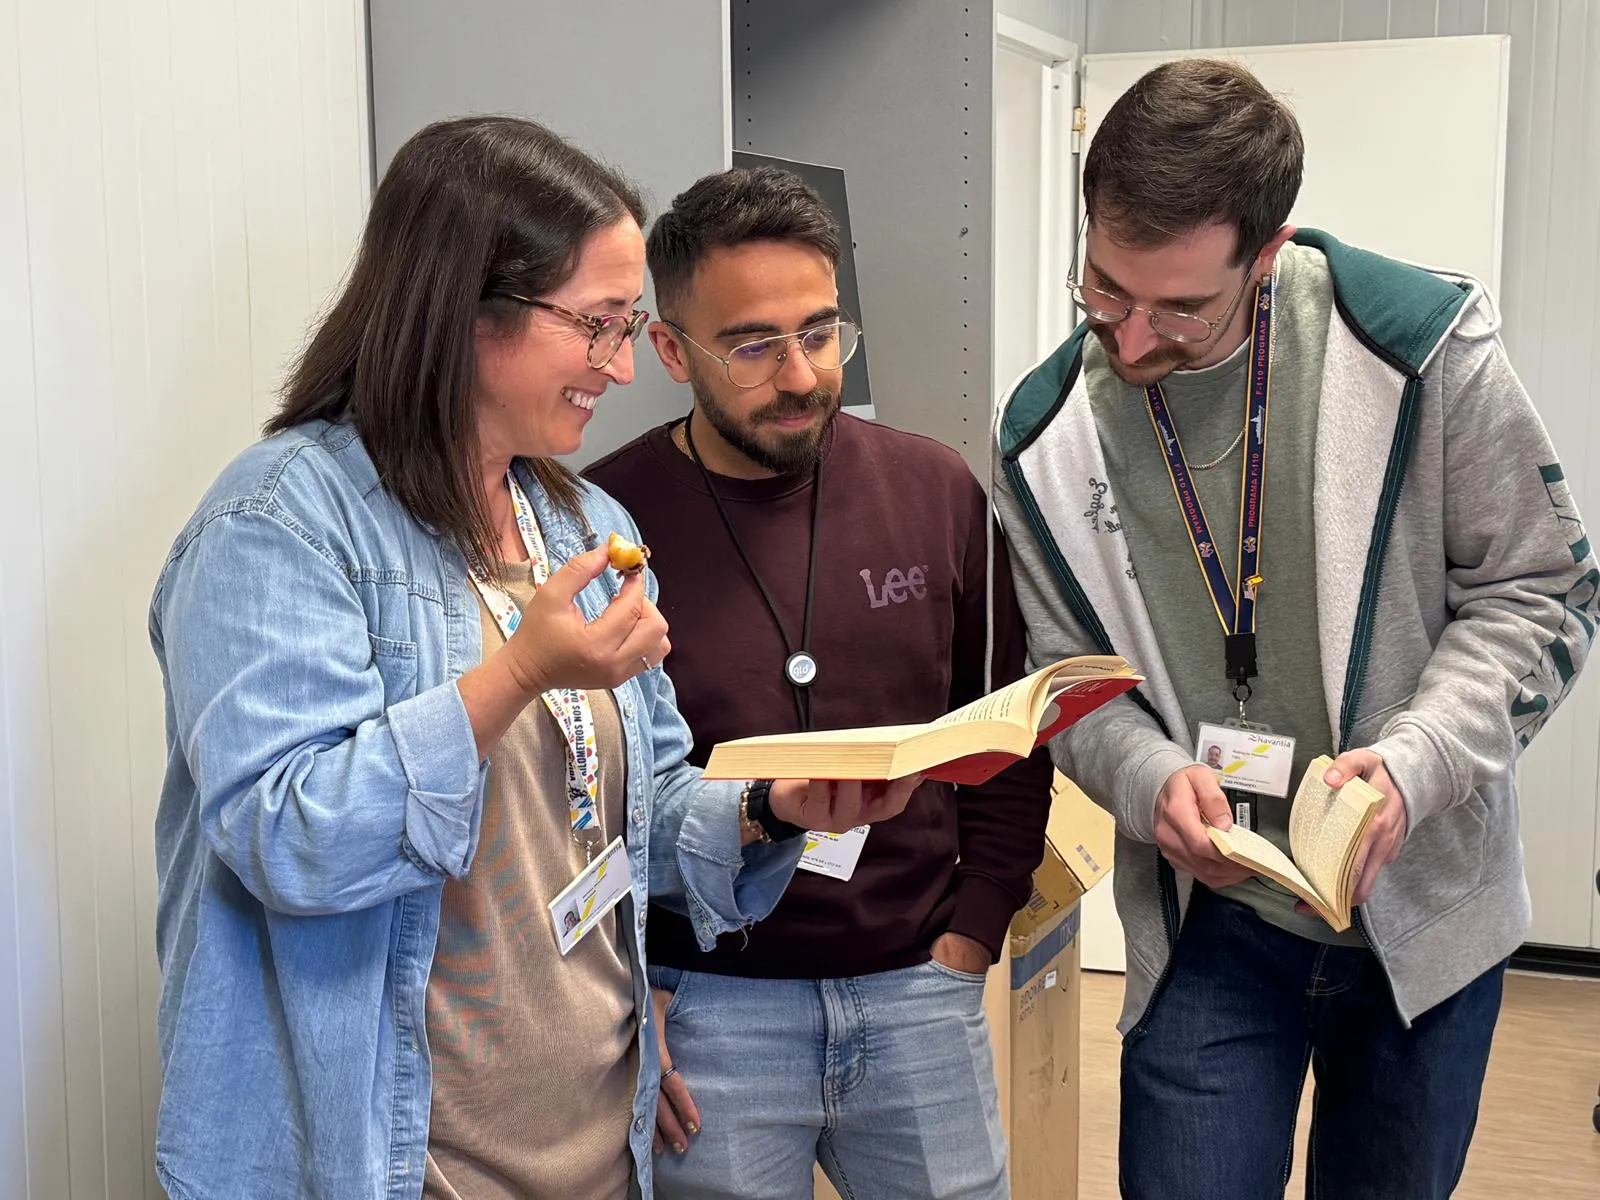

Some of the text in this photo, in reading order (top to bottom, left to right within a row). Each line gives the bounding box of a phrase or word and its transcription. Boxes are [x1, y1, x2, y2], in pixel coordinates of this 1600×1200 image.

[1257, 320, 1267, 368] PROGRAM
[1184, 490, 1202, 534] PROGRAM
[1248, 453, 1260, 528] PROGRAMA F-110
[859, 566, 928, 609] Lee
[572, 705, 582, 722] NOS
[1257, 735, 1291, 748] Navantia
